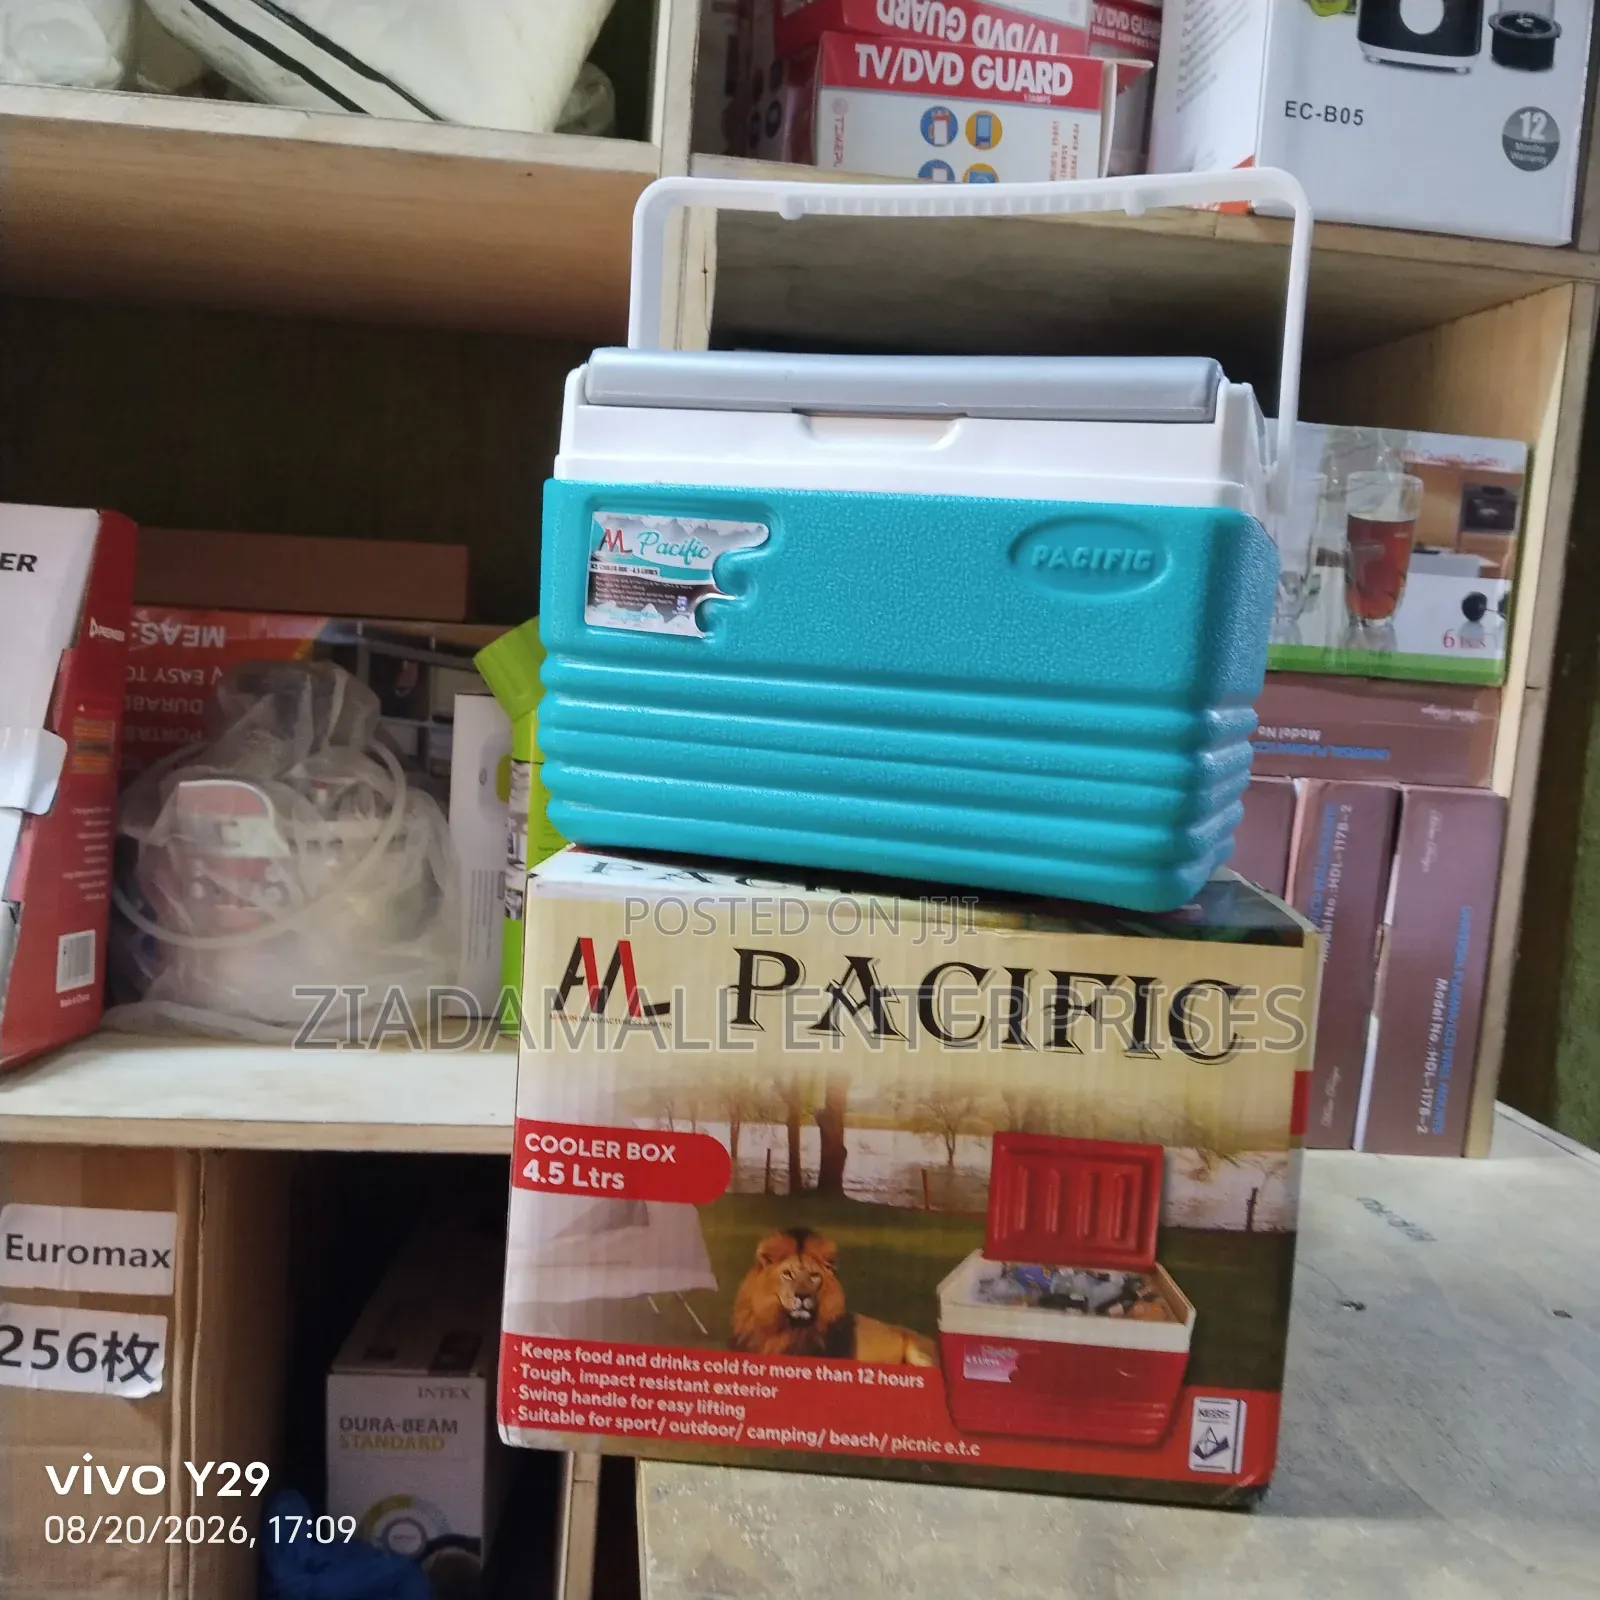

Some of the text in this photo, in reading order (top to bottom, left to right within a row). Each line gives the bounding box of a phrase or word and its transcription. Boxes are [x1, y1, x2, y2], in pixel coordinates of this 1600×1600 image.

[855, 43, 1073, 96] TV/DVD GUARD
[1285, 100, 1364, 126] EC-B05
[1520, 111, 1547, 140] 12
[637, 531, 712, 565] Pacific
[1031, 545, 1155, 571] PACIFIC
[153, 666, 203, 685] EASY
[126, 696, 204, 715] DURABL
[727, 947, 1249, 1066] PACIFIC
[524, 1133, 677, 1164] COOLER BOX
[522, 1158, 625, 1191] 4.5 Ltrs
[6, 1232, 171, 1269] Euromax
[0, 1324, 160, 1384] 256枚
[521, 1342, 925, 1388] Keeps food and drinks cold for more than 12 hours
[418, 1386, 471, 1400] INTEX
[520, 1363, 779, 1399] Tough, impact resistant exterior
[518, 1384, 746, 1421] Swing handle for easy lifting
[339, 1416, 459, 1435] DURA-BEAM
[518, 1405, 585, 1426] Suitable
[588, 1411, 613, 1428] for
[615, 1416, 667, 1436] sport/
[669, 1419, 744, 1442] outdoor/
[747, 1424, 826, 1448] camping/
[829, 1429, 888, 1453] beach/
[891, 1434, 941, 1455] picnic
[340, 1434, 446, 1451] STANDARD
